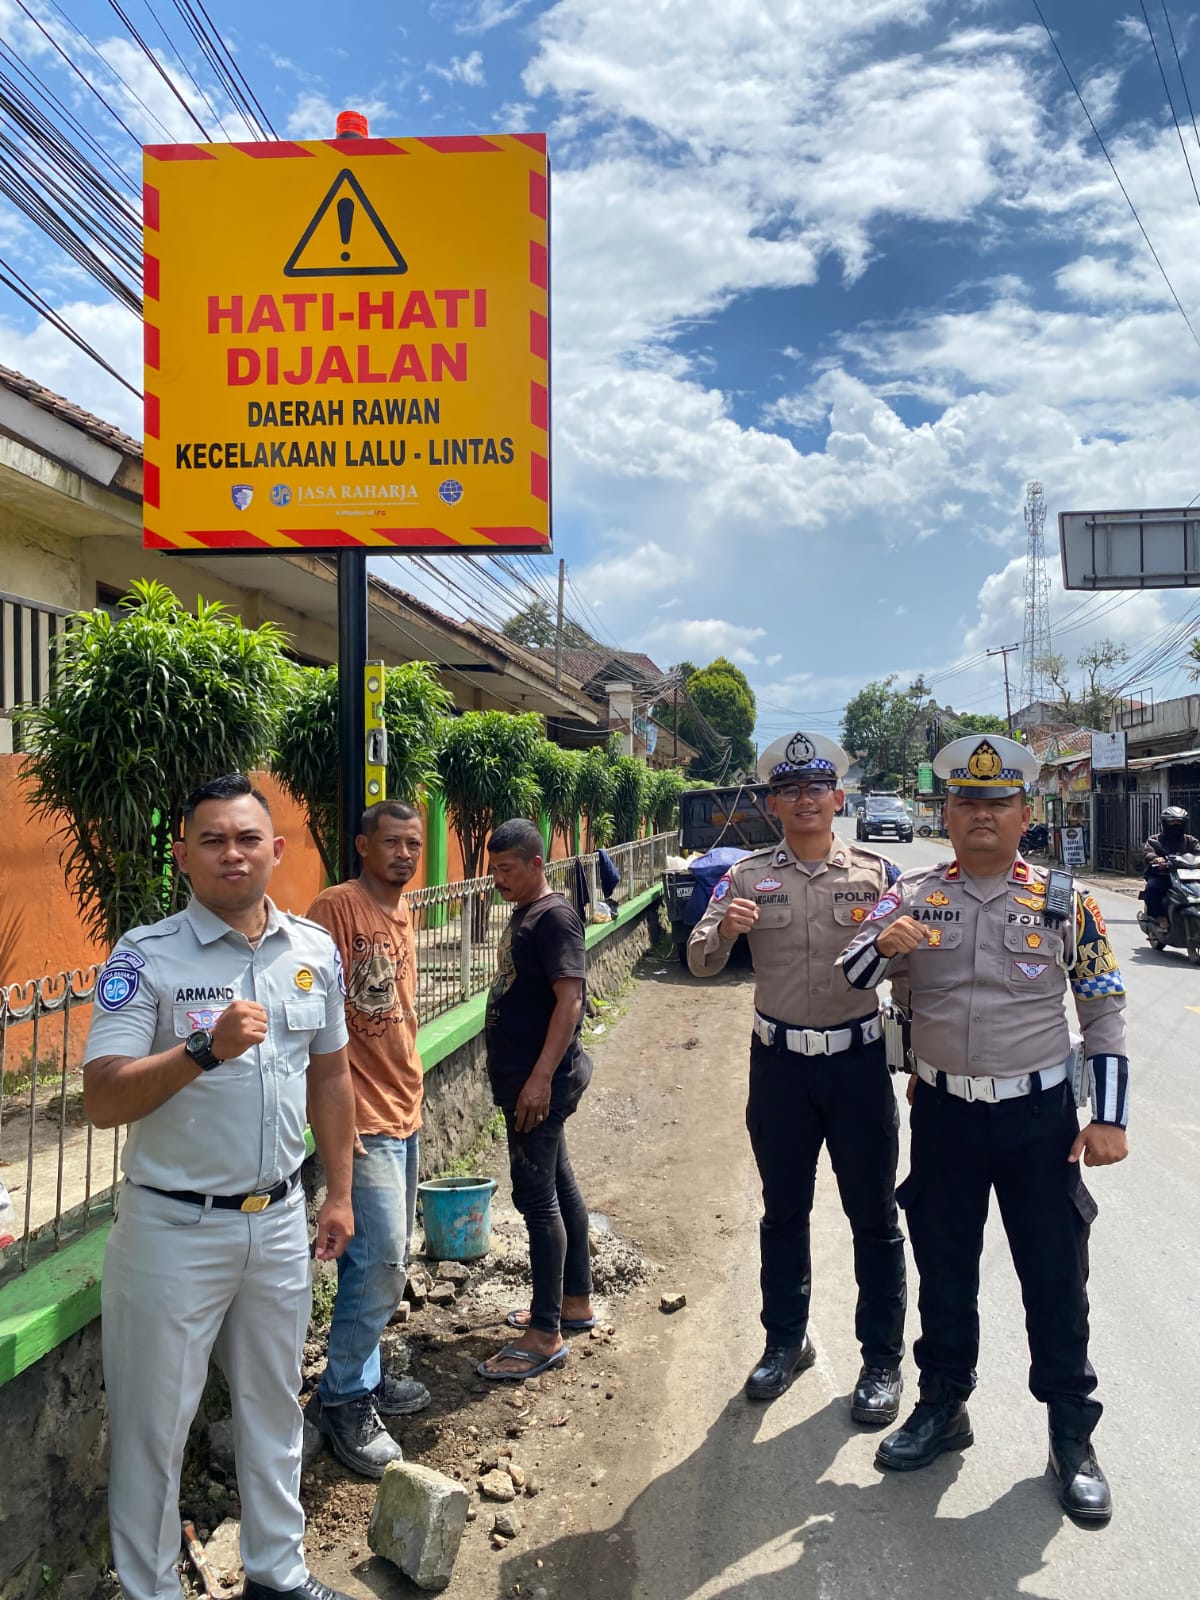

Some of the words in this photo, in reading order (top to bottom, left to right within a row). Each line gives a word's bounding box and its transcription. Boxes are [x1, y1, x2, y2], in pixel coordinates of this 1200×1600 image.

[208, 289, 486, 334] HATI-HATI
[227, 343, 467, 386] DIJALAN
[248, 400, 343, 427] DAERAH
[353, 398, 440, 425] RAWAN
[176, 441, 336, 469] KECELAKAAN
[346, 440, 405, 466] LALU
[429, 437, 514, 465] LINTAS
[298, 485, 337, 500] JASA
[341, 484, 418, 500] RAHARJA
[834, 892, 876, 902] POLRI
[912, 910, 960, 922] SANDI
[1008, 914, 1060, 930] POLRI
[176, 987, 234, 1001] ARMAND
